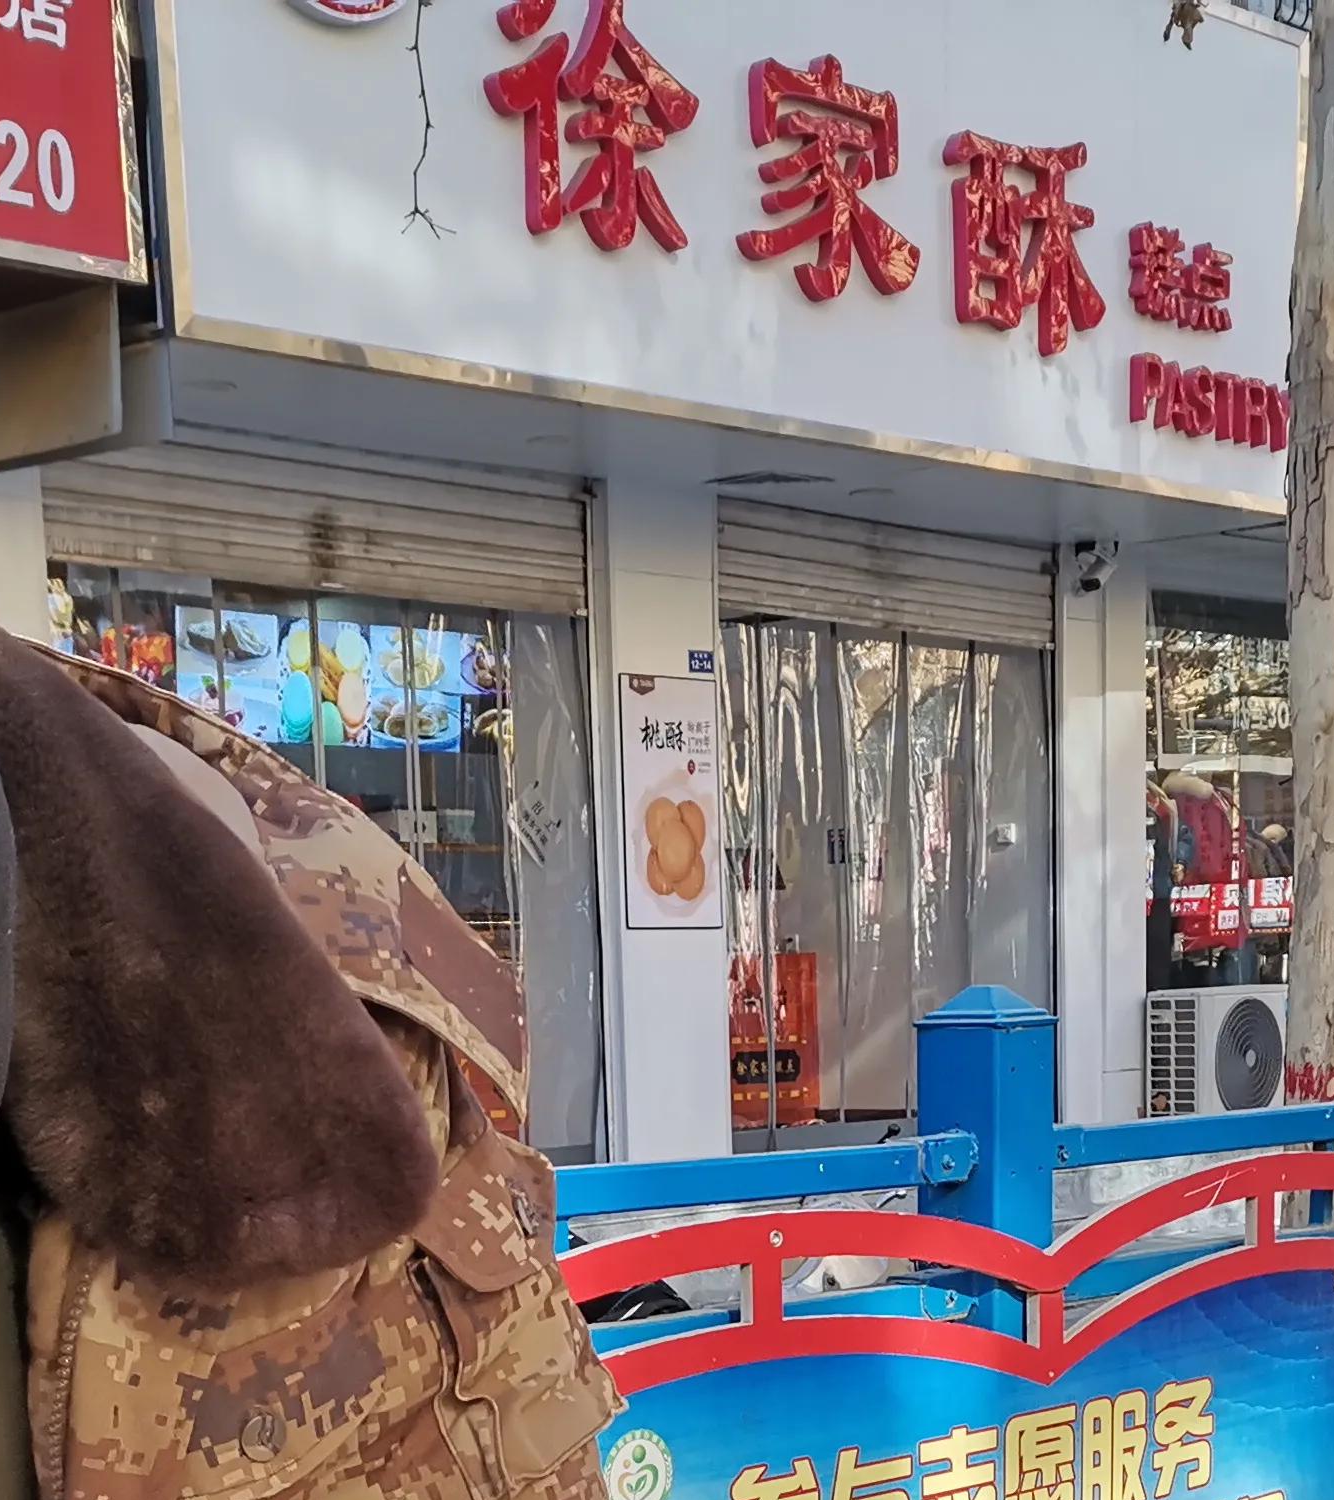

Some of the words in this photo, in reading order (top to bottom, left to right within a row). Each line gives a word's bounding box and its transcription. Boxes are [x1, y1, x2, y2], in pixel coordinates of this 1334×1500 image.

[483, 0, 1106, 357] 徐家酥
[639, 716, 686, 752] 桃酥
